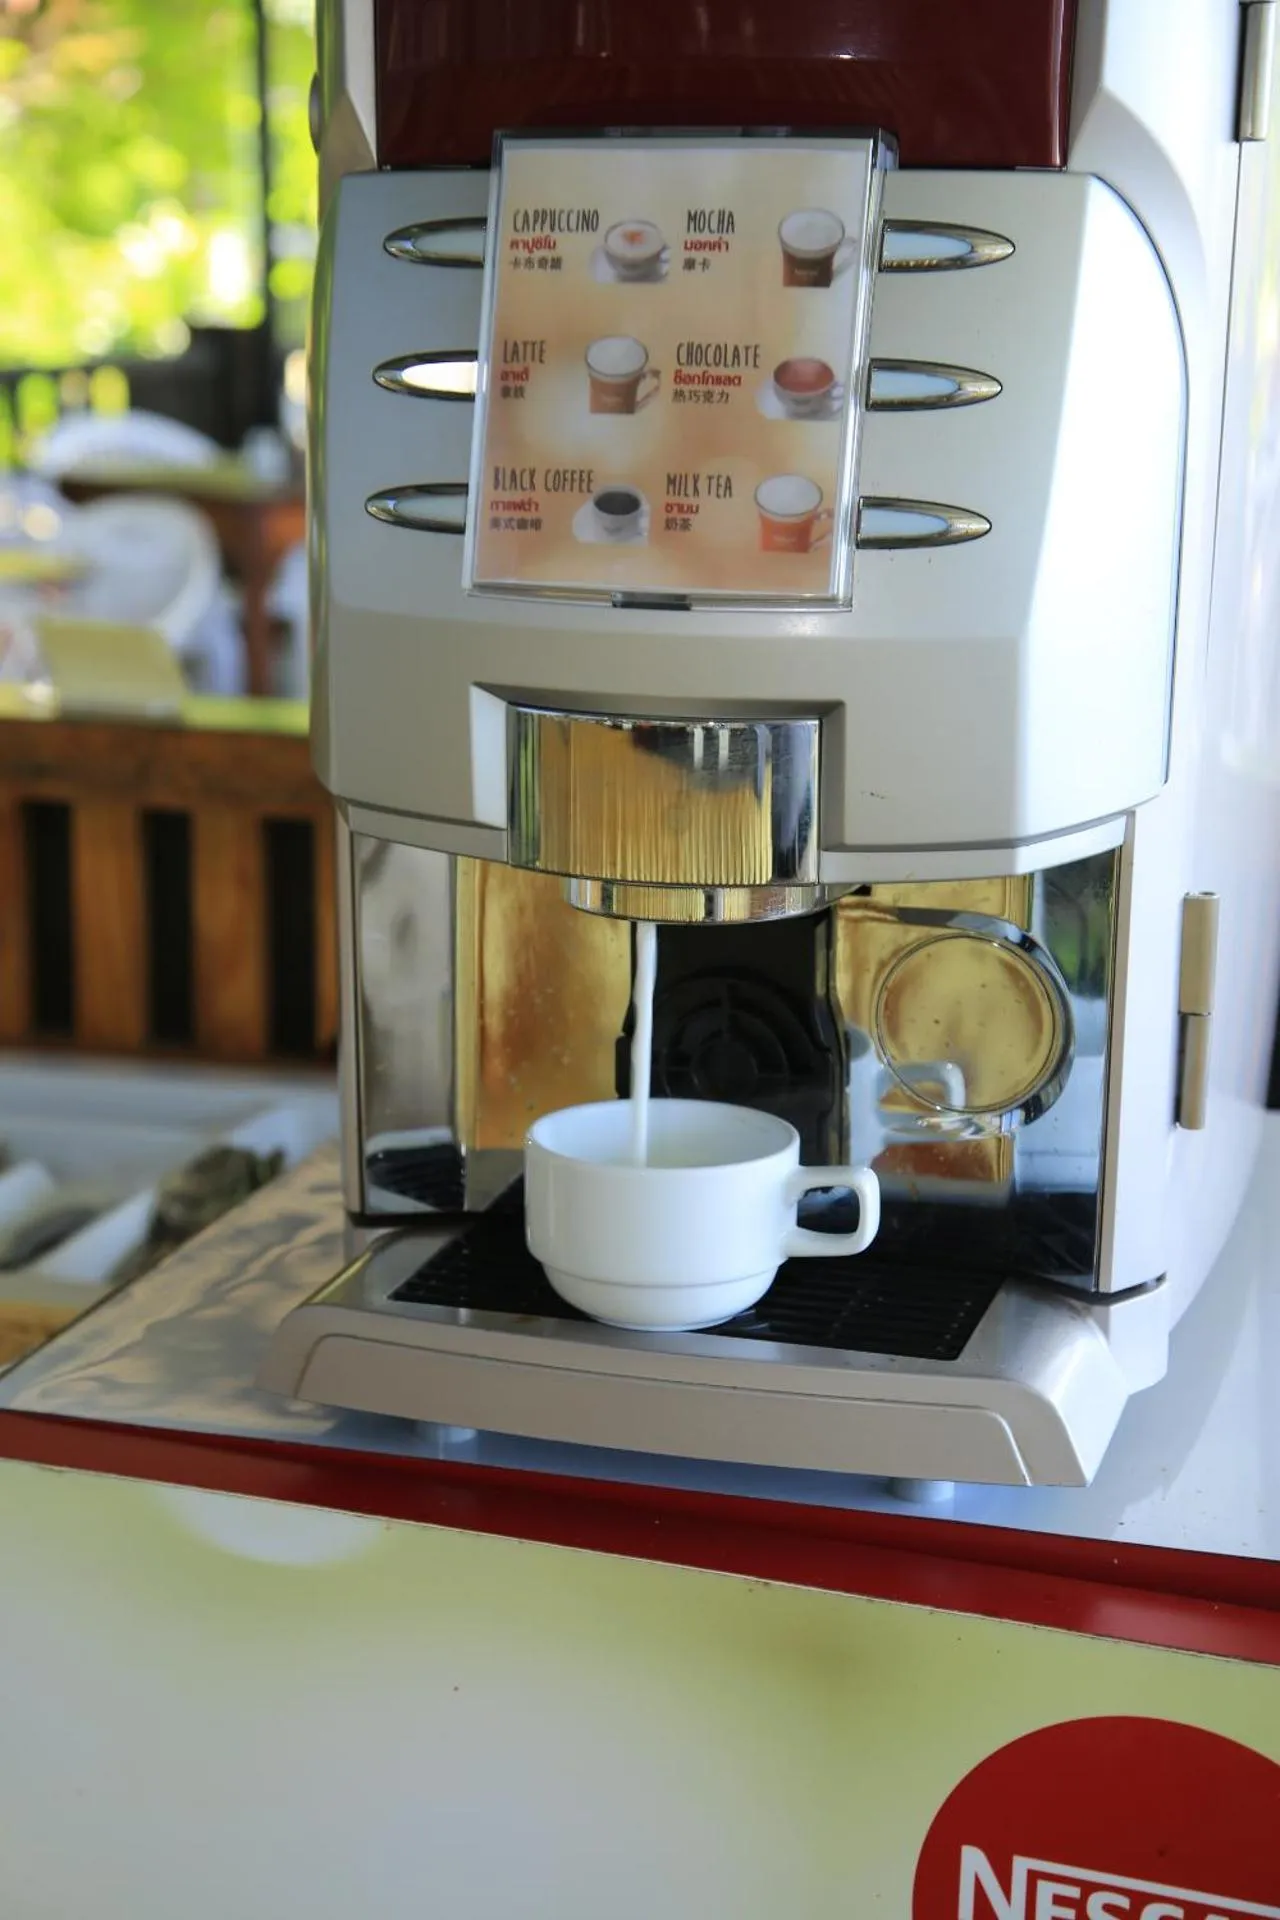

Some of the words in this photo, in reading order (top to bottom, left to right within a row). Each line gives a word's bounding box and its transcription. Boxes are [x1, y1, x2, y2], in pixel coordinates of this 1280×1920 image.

[513, 208, 600, 233] CAPPUCCINO
[686, 209, 736, 235] MOCHA
[503, 339, 546, 365] LATTE
[676, 340, 761, 369] CHOCOLATE
[493, 466, 537, 492] BLACK
[544, 468, 594, 494] COFFEE
[665, 473, 700, 498] MILK
[706, 474, 733, 499] TEA
[663, 517, 693, 533] 奶茶
